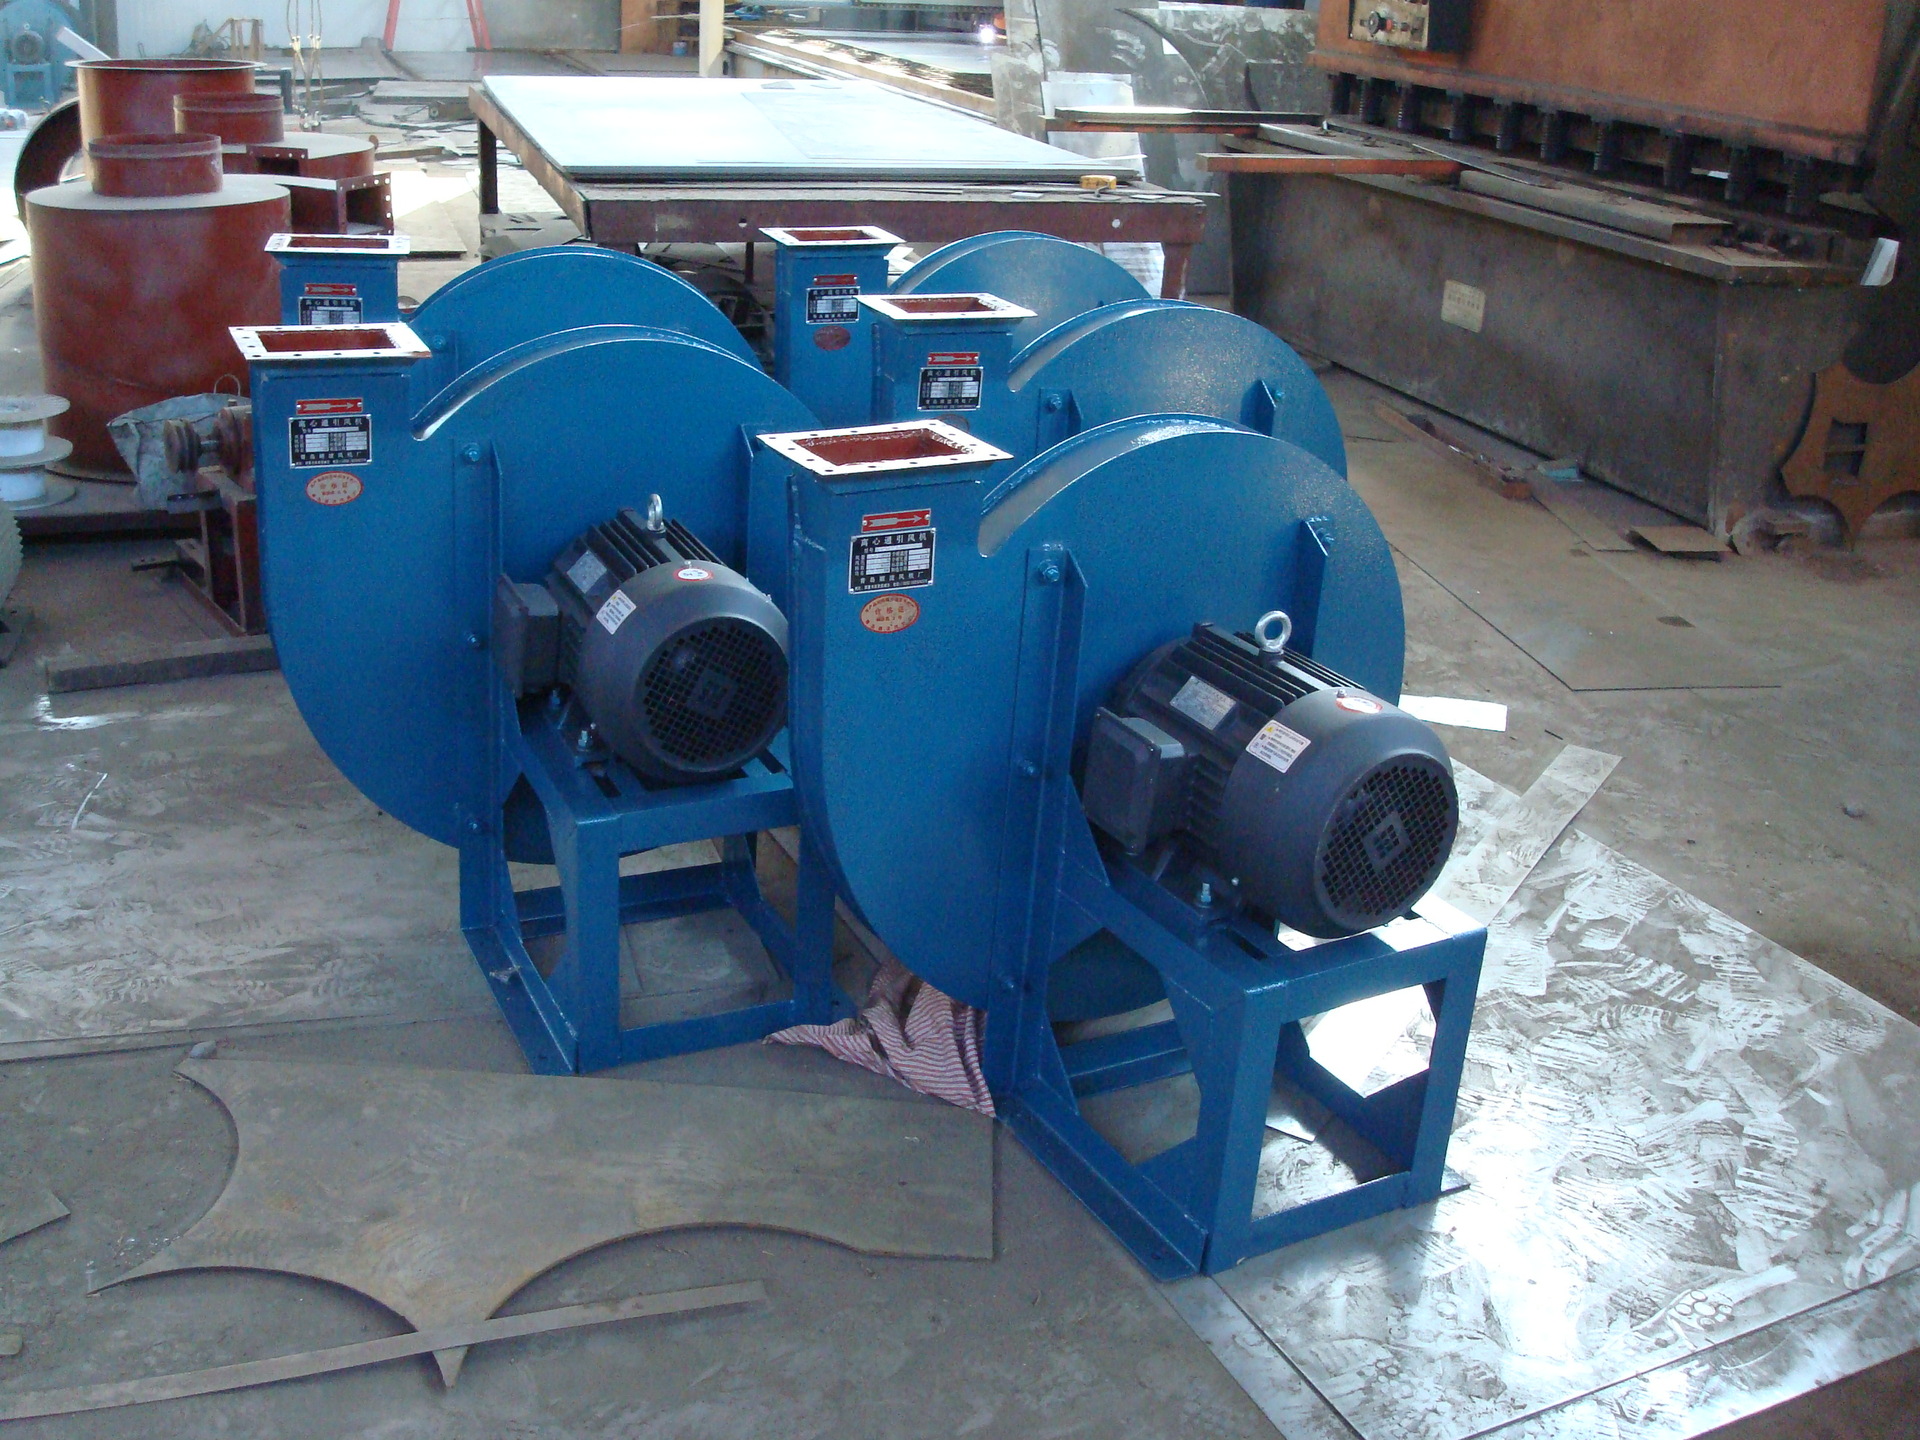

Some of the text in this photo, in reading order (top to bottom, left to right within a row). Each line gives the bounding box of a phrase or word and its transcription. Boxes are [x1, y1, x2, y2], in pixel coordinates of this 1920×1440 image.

[860, 532, 927, 547] 离心通引风机
